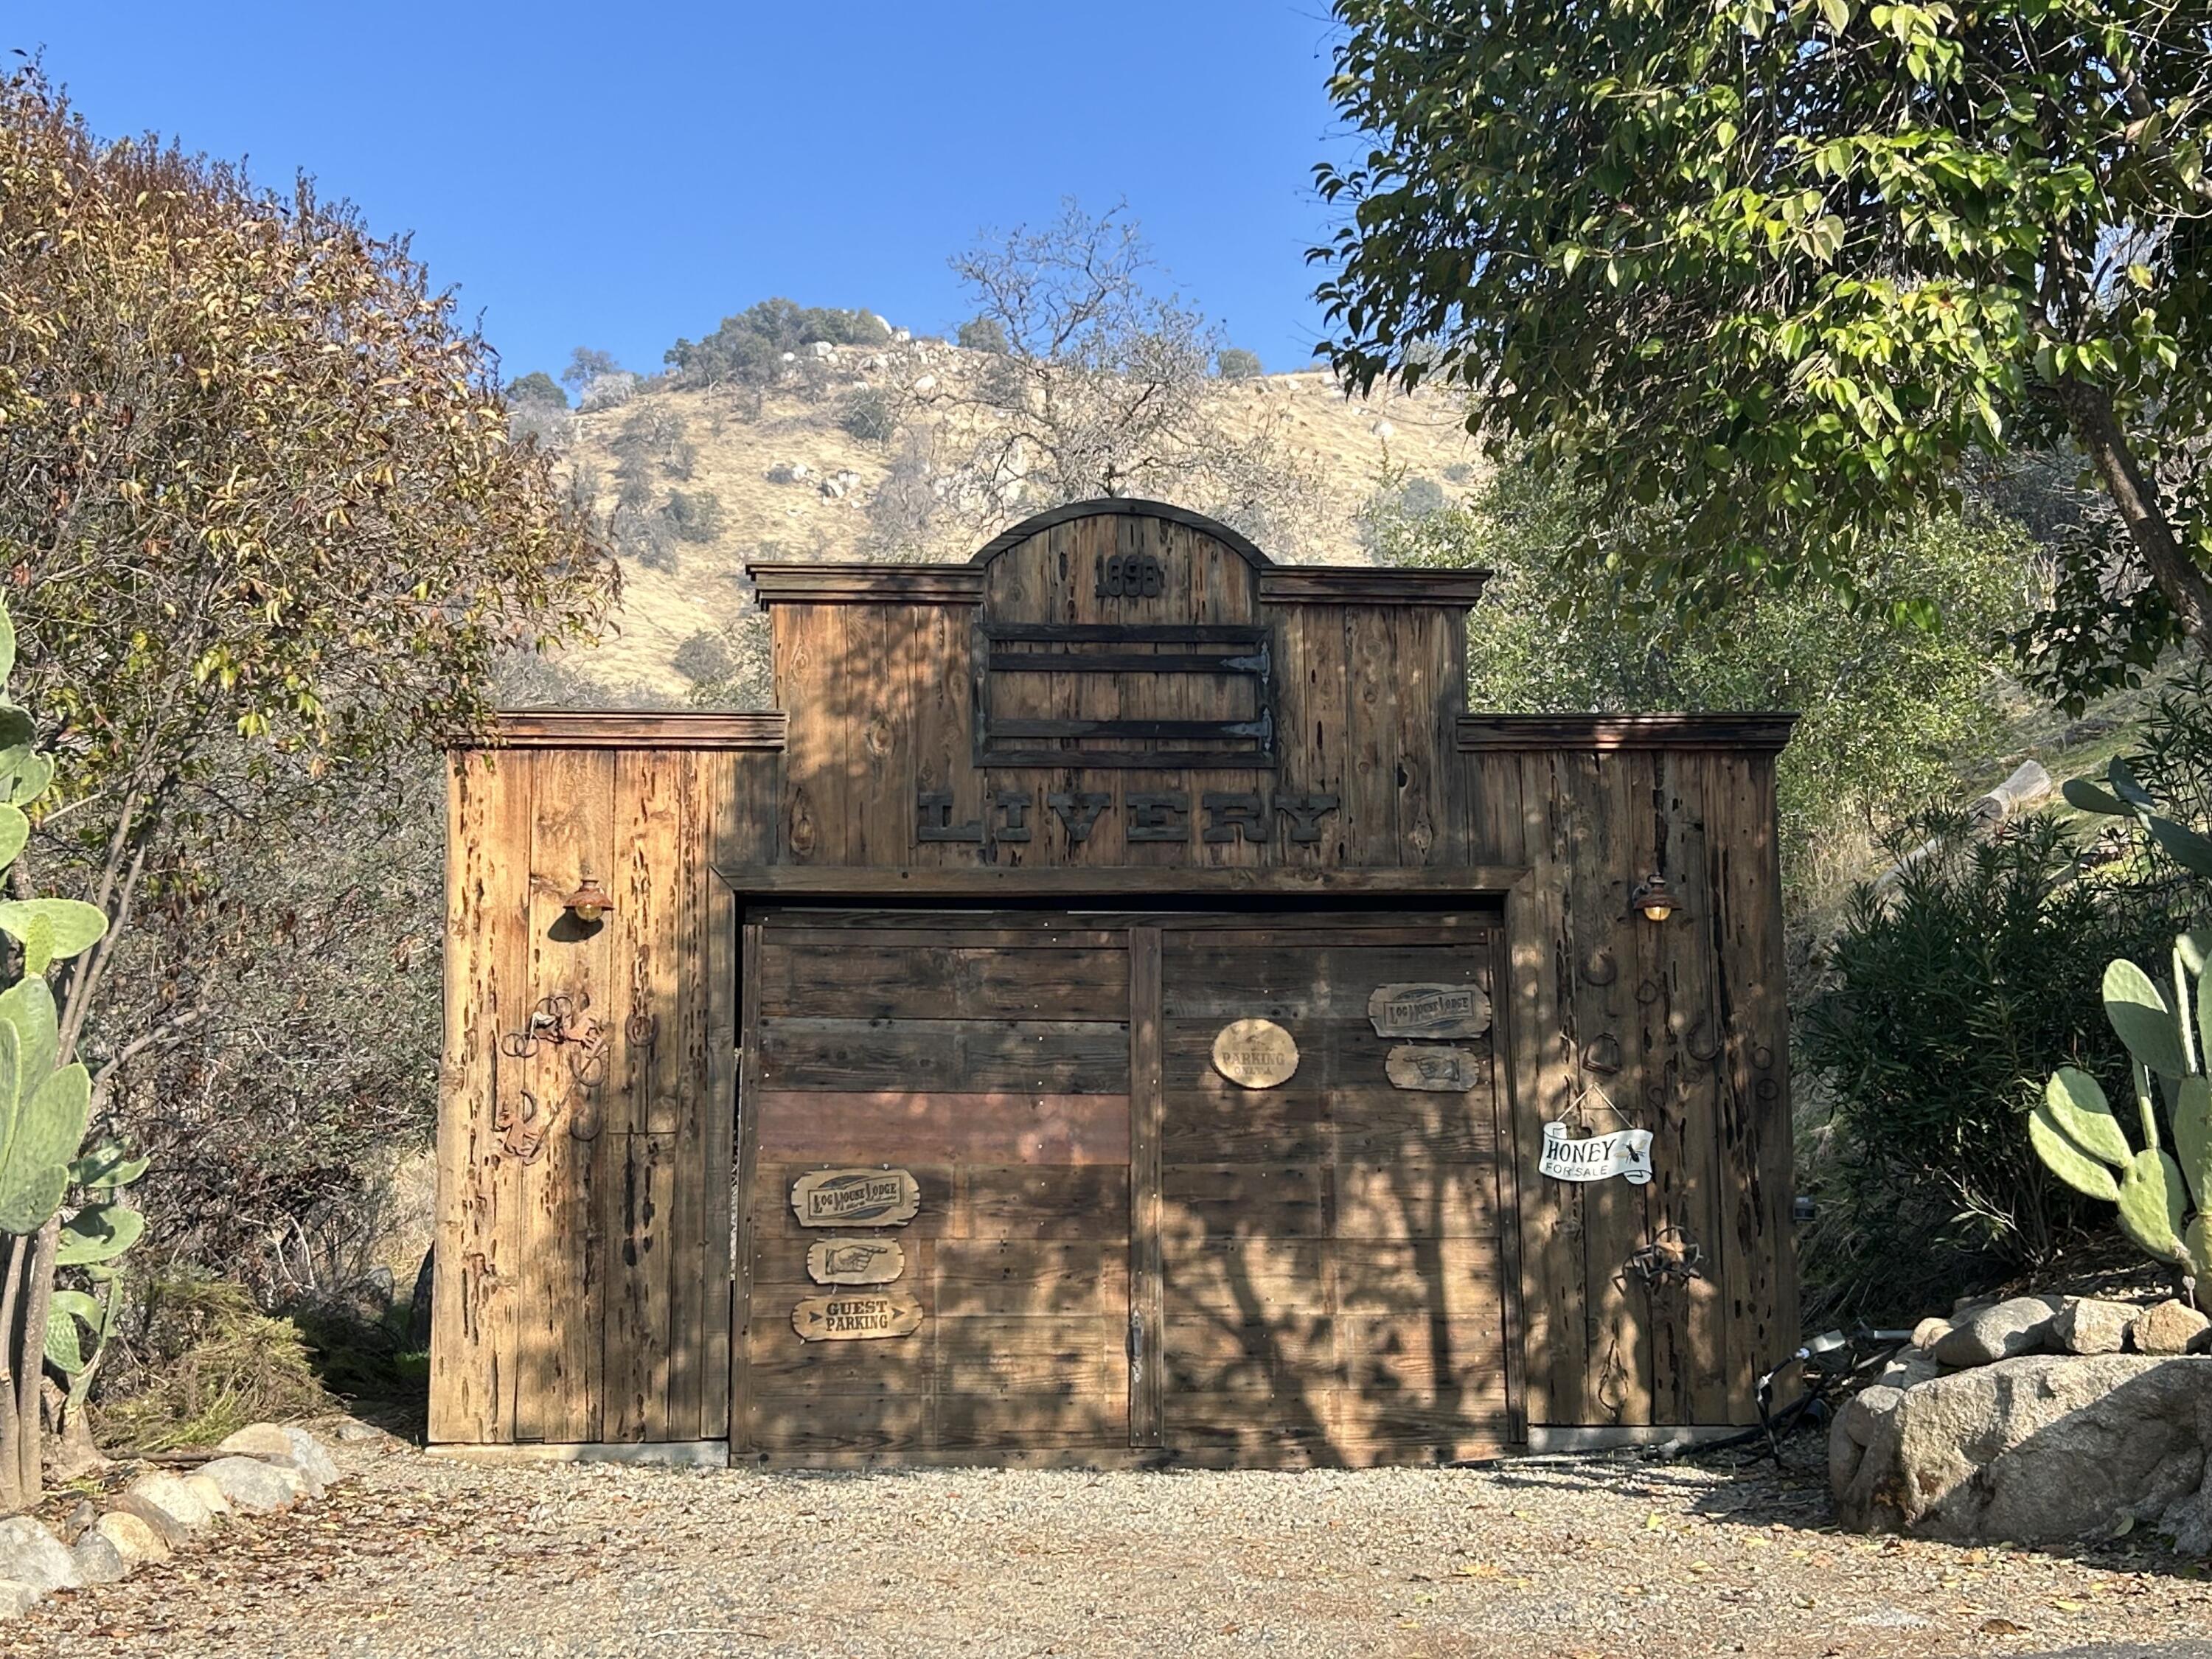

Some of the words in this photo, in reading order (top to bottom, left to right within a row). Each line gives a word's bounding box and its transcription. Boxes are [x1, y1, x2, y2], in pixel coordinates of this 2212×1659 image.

[1095, 554, 1158, 598] 1898
[918, 791, 1339, 842] LIVERY
[1222, 1051, 1285, 1065] PARKING
[1546, 1138, 1617, 1163] HONEY
[1546, 1162, 1571, 1176] FOR
[1576, 1165, 1608, 1176] SALE
[813, 1194, 832, 1213] LOG
[865, 1183, 897, 1201] LODGE
[826, 1300, 888, 1315] GUEST
[826, 1314, 888, 1331] PARKING
